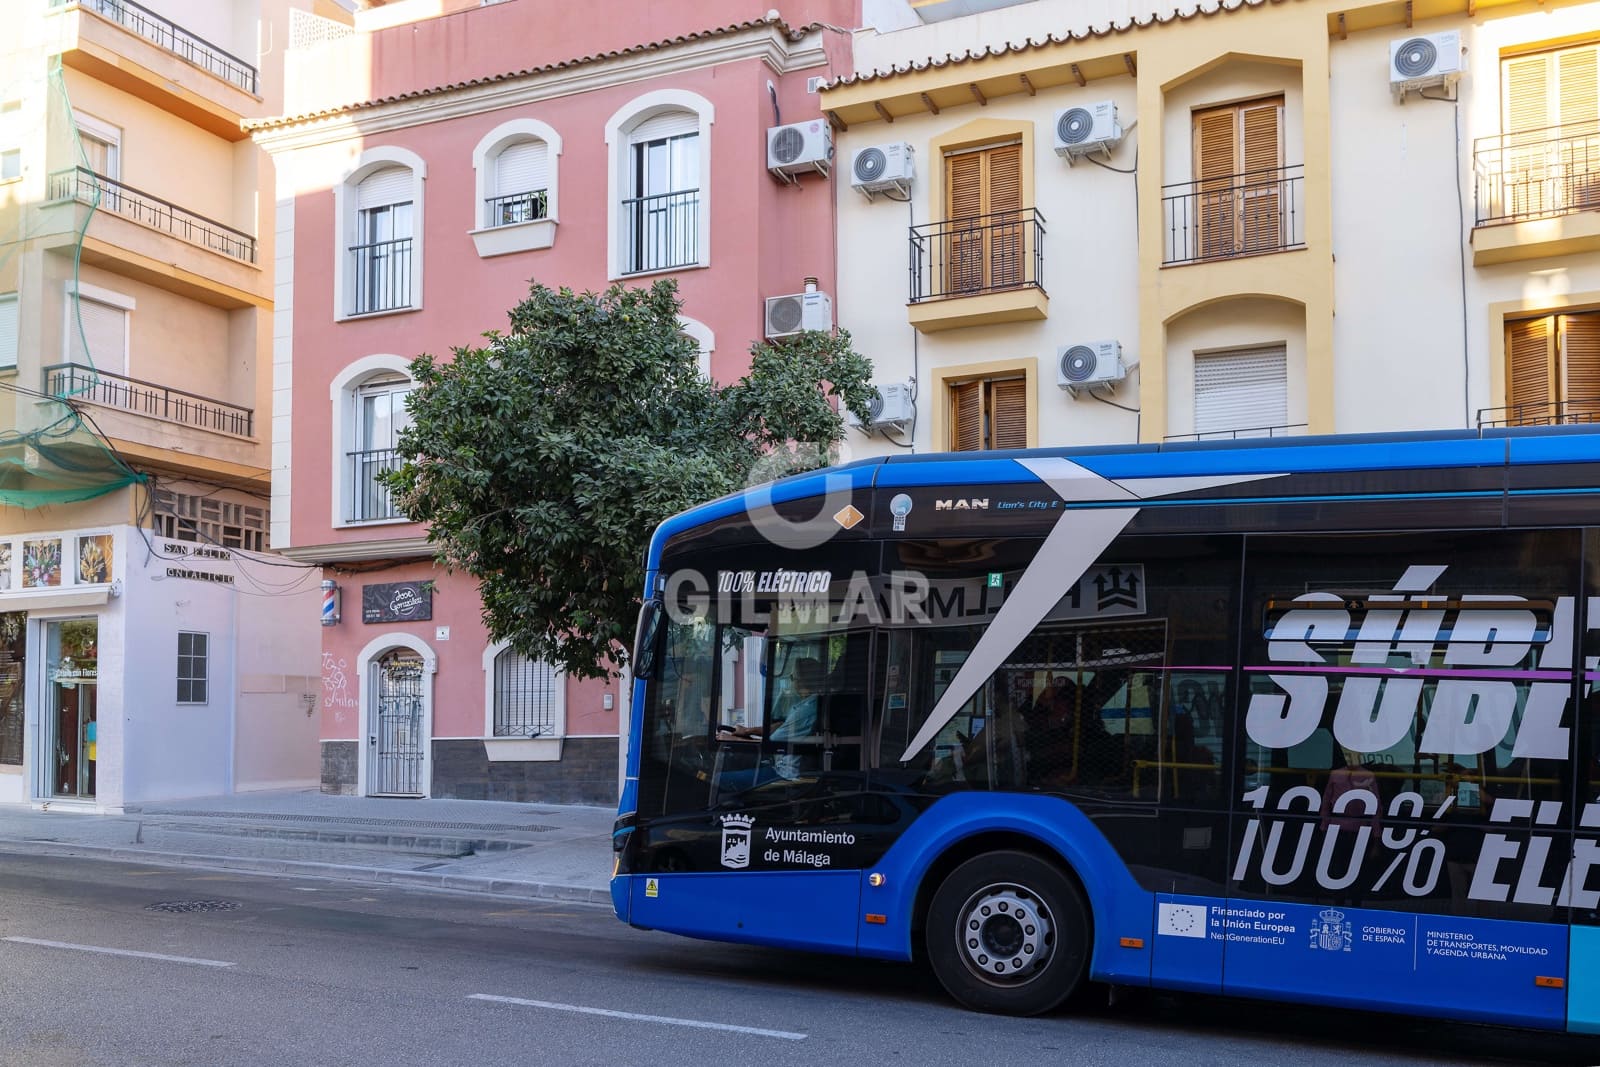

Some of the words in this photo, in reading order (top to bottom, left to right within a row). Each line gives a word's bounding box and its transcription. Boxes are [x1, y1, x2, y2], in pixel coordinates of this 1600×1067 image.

[935, 498, 990, 511] MAN
[997, 501, 1025, 510] Lion's
[1028, 500, 1048, 510] City
[1051, 500, 1059, 508] E
[164, 543, 188, 556] SAN
[717, 571, 755, 593] 100%
[756, 567, 832, 593] ELÉCTRICO
[765, 827, 856, 845] Ayuntamiento
[1232, 784, 1457, 897] 100%
[764, 848, 780, 862] de
[783, 849, 831, 867] Málaga
[1211, 906, 1266, 918] Financiado
[1268, 912, 1286, 921] por
[1211, 918, 1220, 927] la
[1222, 918, 1251, 929] Unión
[1254, 921, 1296, 934] Europea
[1362, 926, 1406, 936] GOBIERNO
[1210, 931, 1285, 945] NextGenerationEU
[1362, 934, 1373, 942] DE
[1375, 934, 1405, 944] ESPAÑA
[1427, 931, 1474, 941] MINISTERIO
[1426, 947, 1432, 955] Y
[1433, 948, 1469, 957] AGENDA
[1470, 951, 1507, 961] URBANA
[1427, 939, 1438, 947] DE
[1439, 940, 1499, 952] TRANSPORTES,
[1500, 945, 1548, 956] MOVILIDAD
